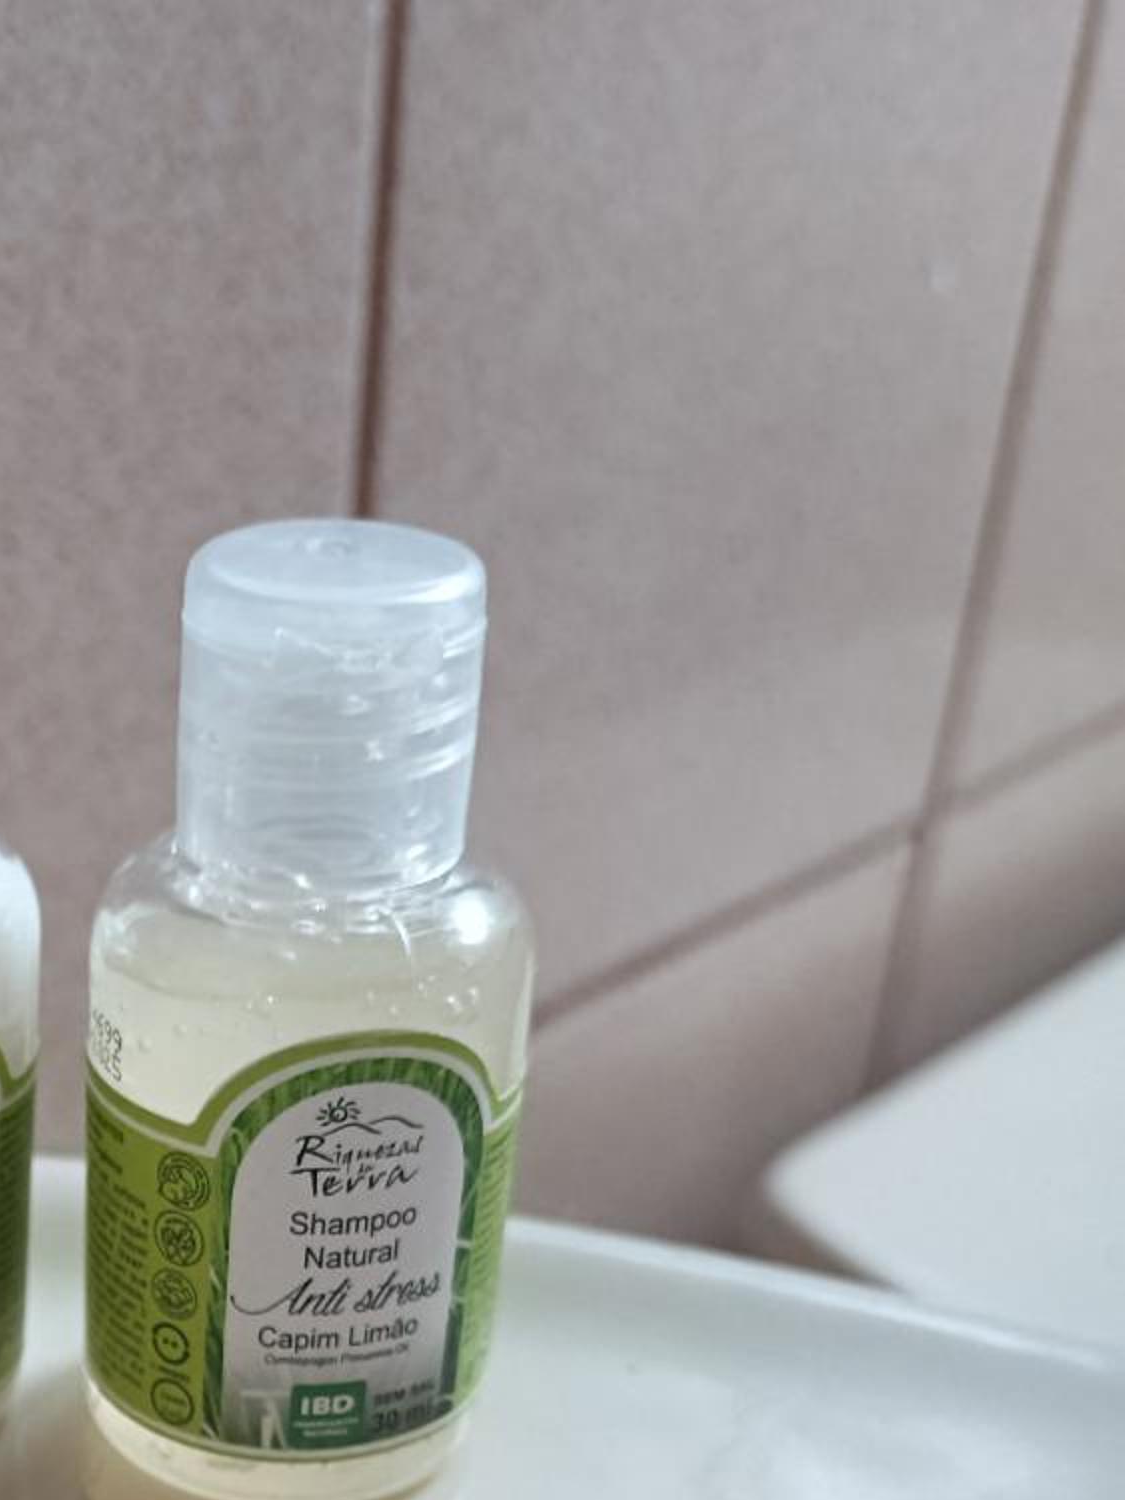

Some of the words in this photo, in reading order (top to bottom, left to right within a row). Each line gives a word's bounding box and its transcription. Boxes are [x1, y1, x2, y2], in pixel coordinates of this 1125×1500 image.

[290, 1206, 418, 1242] Shampoo
[302, 1239, 401, 1270] Natural
[230, 1274, 350, 1317] Anti
[353, 1270, 442, 1316] stress
[258, 1325, 340, 1360] Capim
[348, 1317, 419, 1348] Limão
[299, 1395, 355, 1416] IBD
